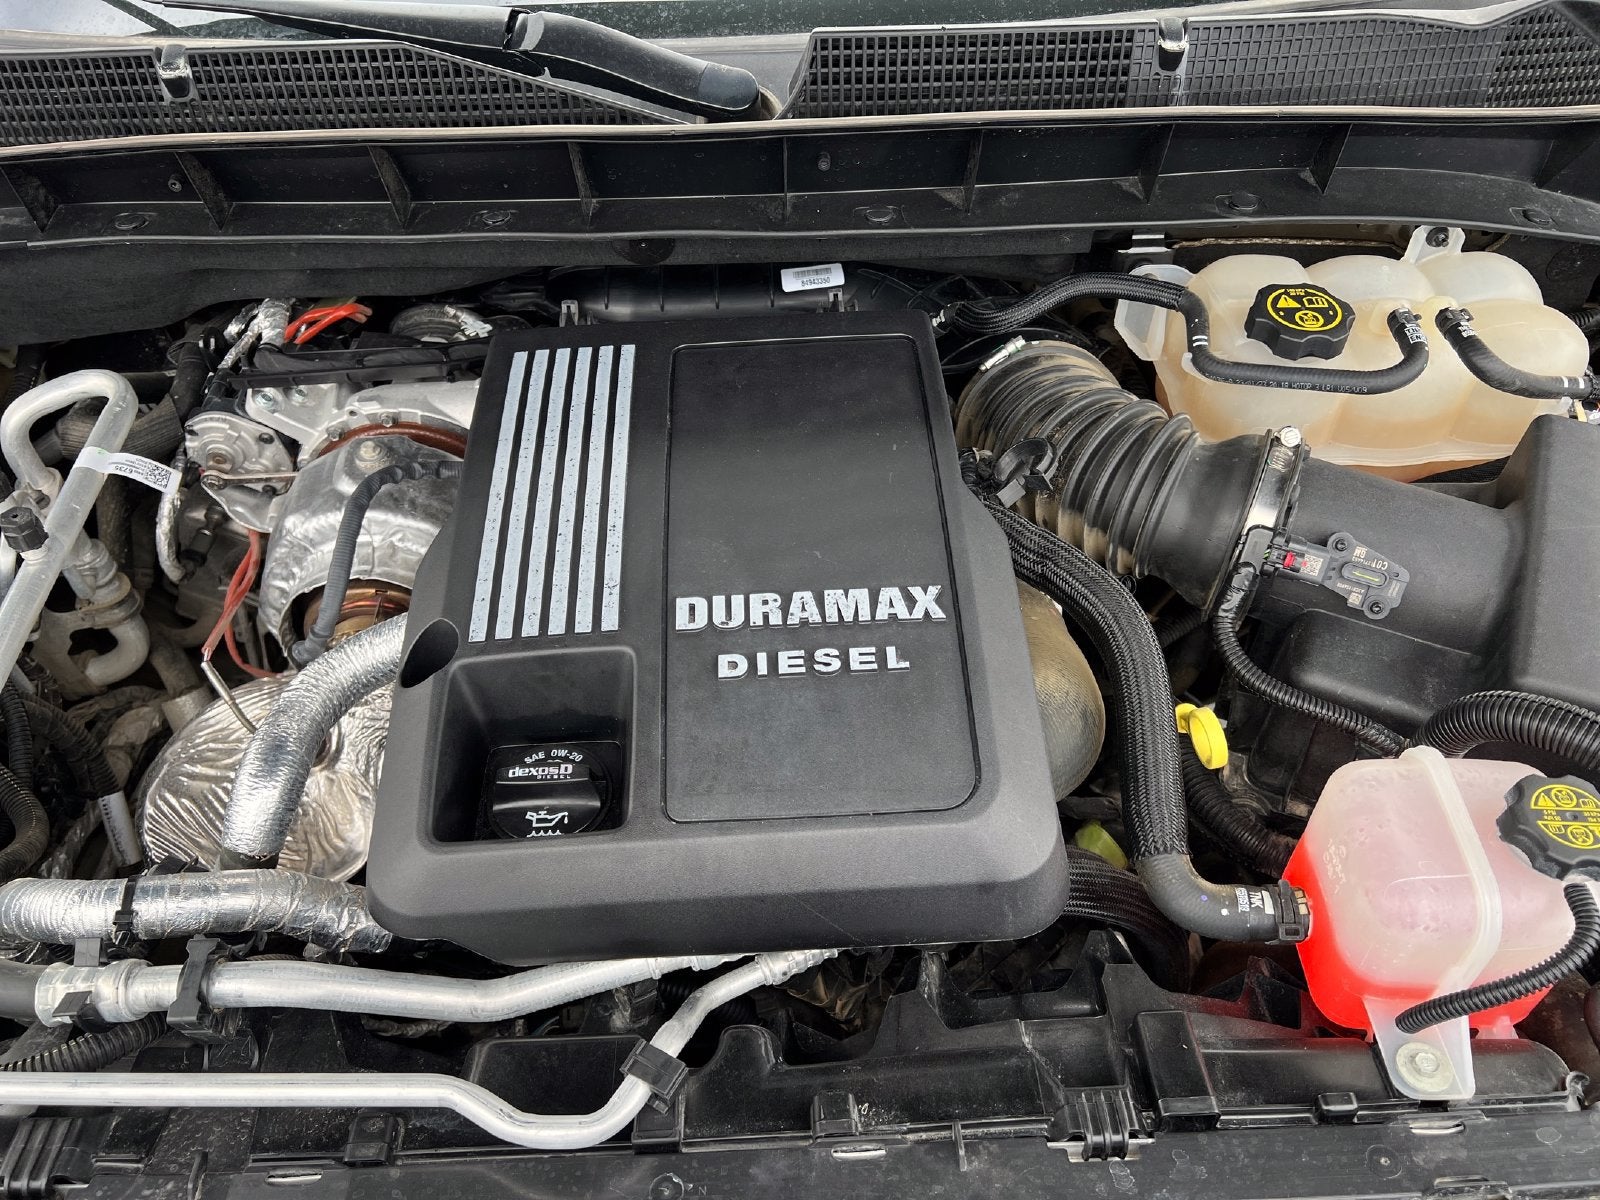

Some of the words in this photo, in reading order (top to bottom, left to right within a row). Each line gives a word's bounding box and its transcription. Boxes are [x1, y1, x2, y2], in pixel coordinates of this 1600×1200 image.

[675, 585, 947, 632] DURAMAX
[717, 646, 910, 679] DIESEL
[524, 751, 545, 763] SAE
[550, 749, 583, 762] 0W-20
